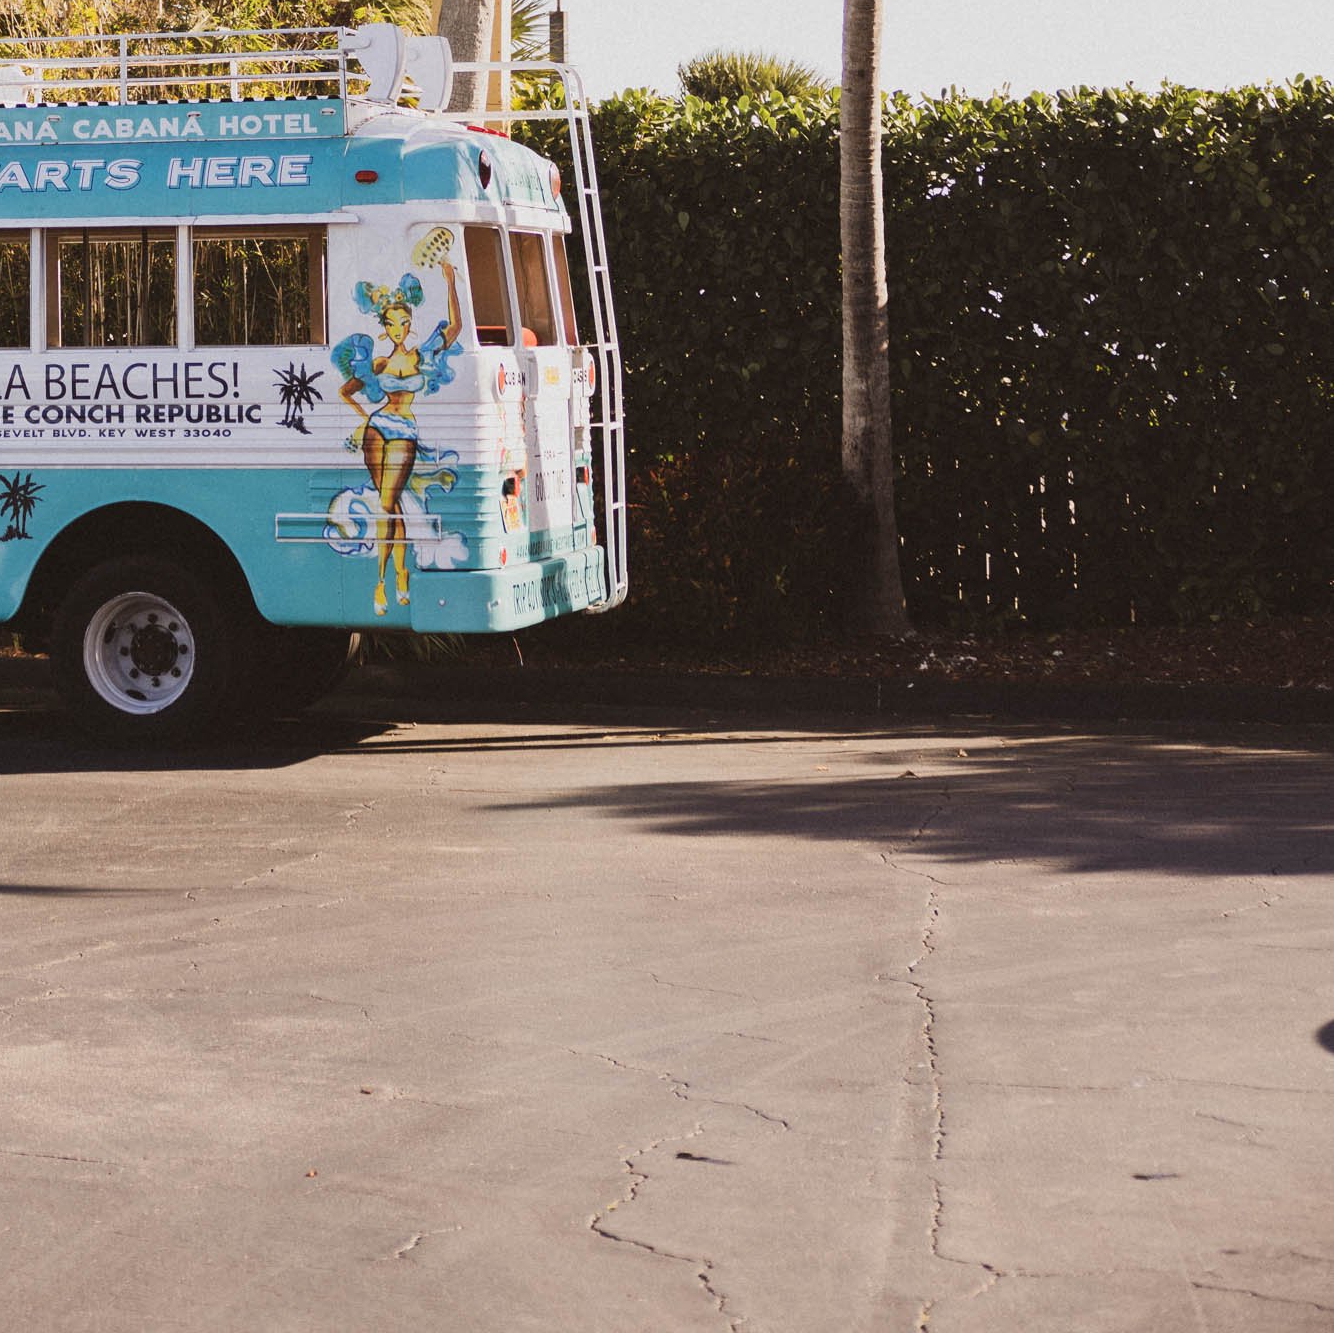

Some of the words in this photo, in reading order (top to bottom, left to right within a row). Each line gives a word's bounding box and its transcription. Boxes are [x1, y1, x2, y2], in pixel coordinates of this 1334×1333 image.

[72, 115, 204, 139] CABANA
[219, 113, 318, 136] HOTEL
[168, 154, 314, 190] HERE
[45, 362, 240, 400] BEACHES!
[24, 404, 125, 425] CONCH
[135, 404, 262, 424] REPUBLIC
[52, 429, 91, 438] BLVD.
[98, 429, 126, 438] KEY
[135, 429, 176, 438] WEST
[183, 429, 232, 438] 33040
